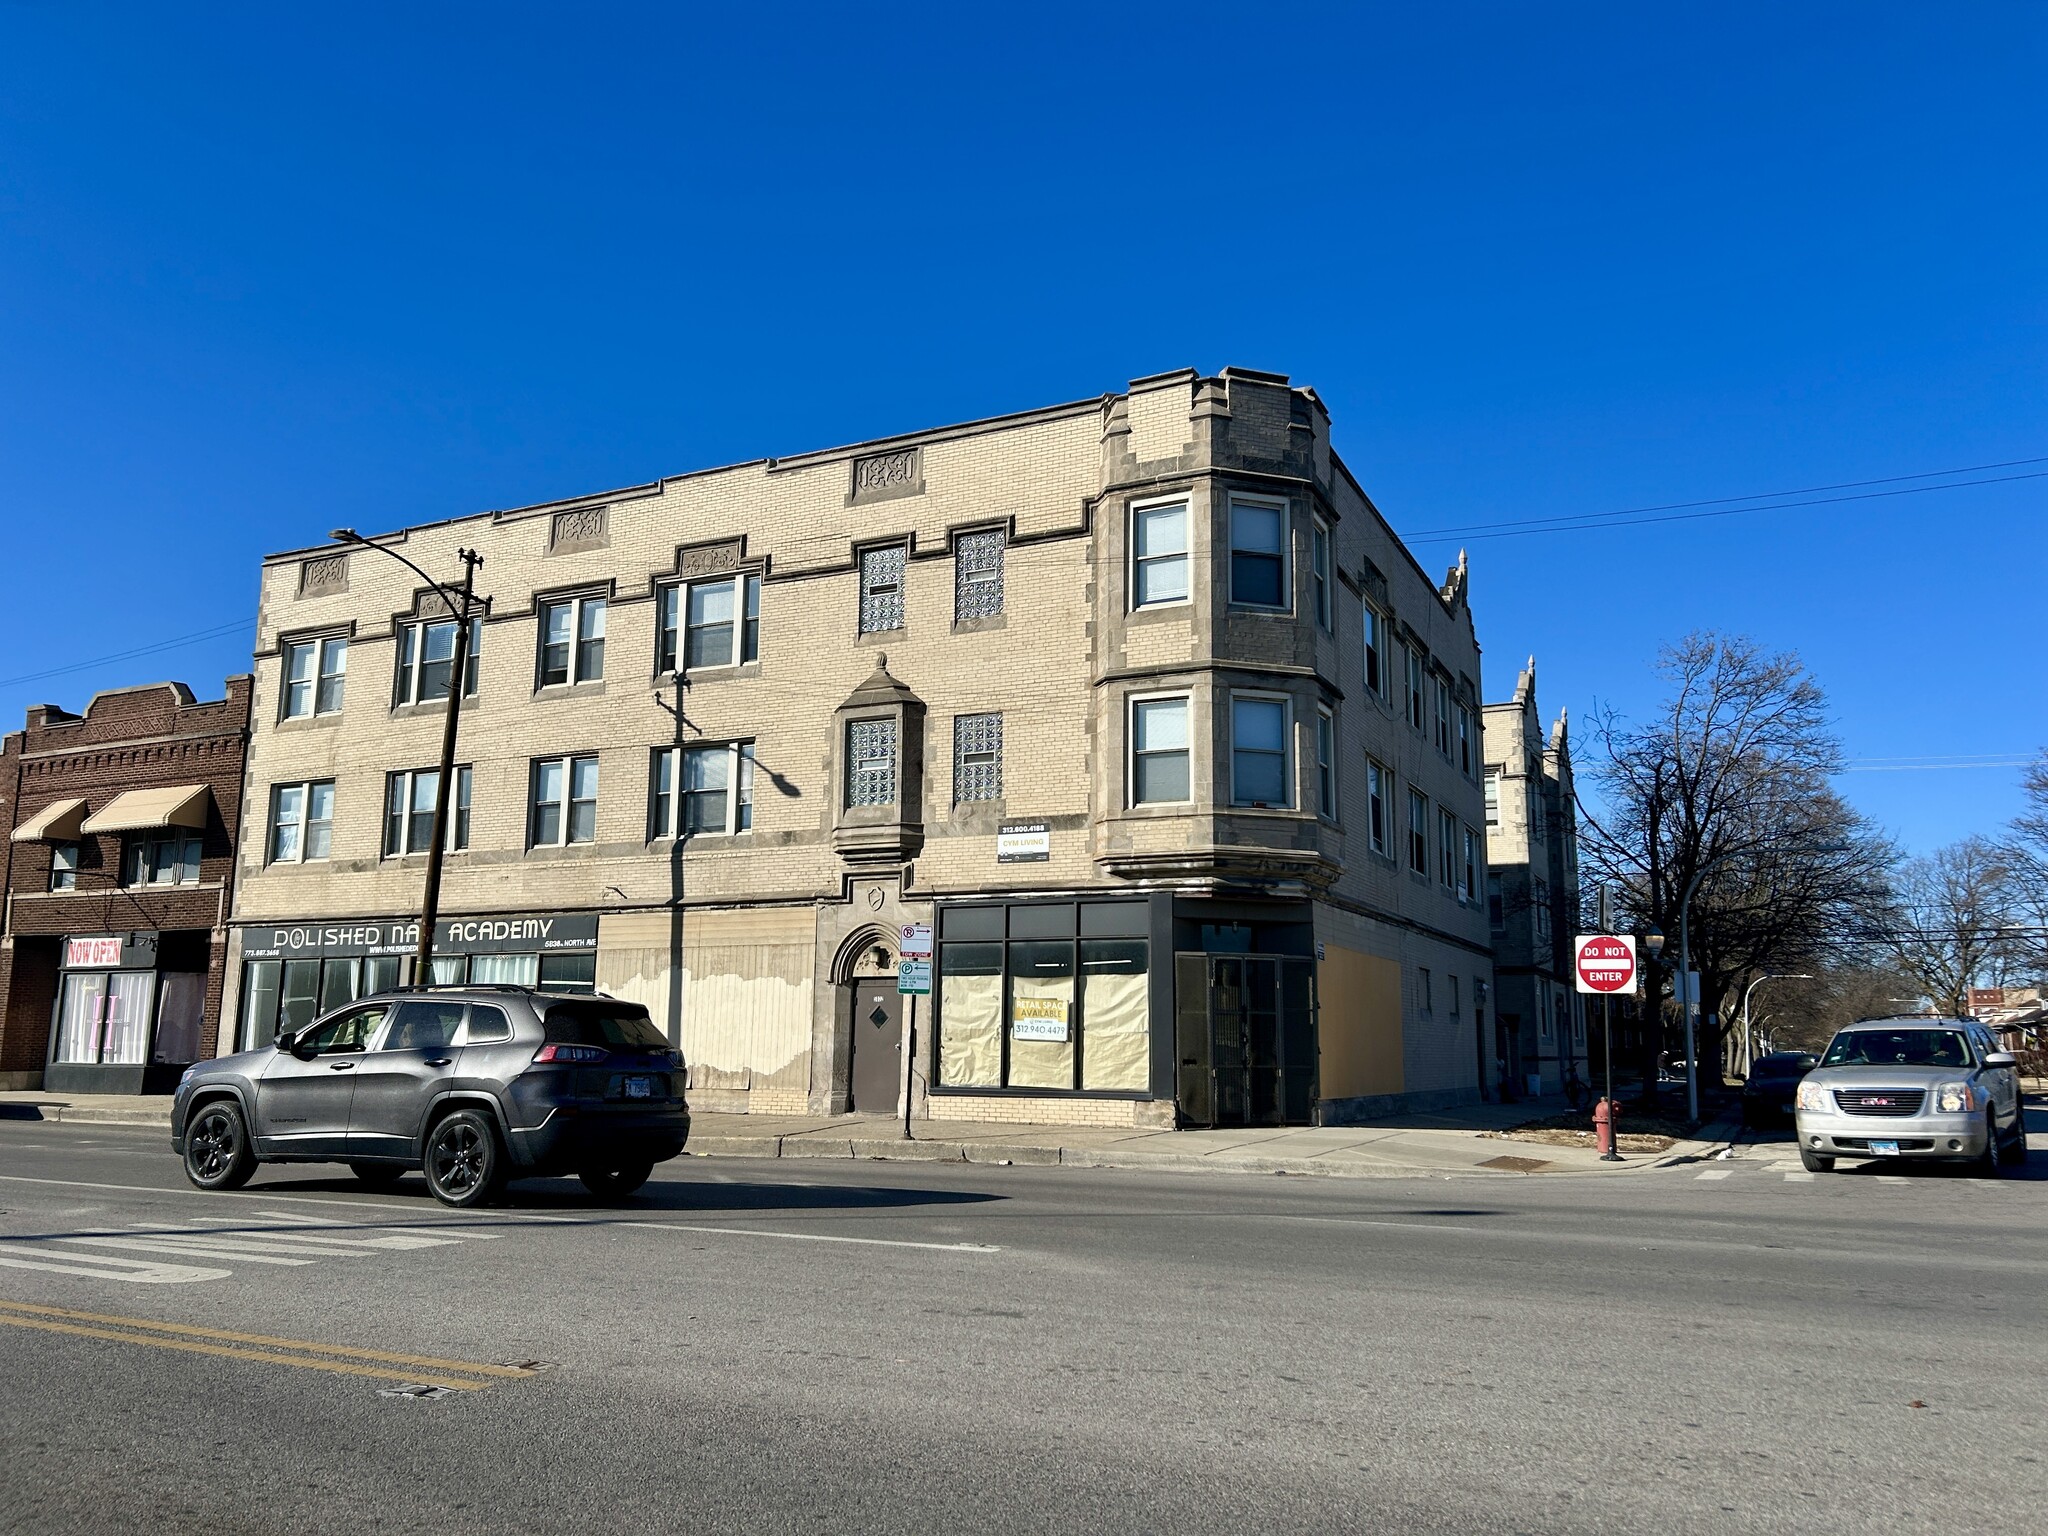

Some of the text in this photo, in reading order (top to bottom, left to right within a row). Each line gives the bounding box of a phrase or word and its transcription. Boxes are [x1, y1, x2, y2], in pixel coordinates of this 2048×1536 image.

[1020, 838, 1044, 846] LIVING
[273, 919, 554, 949] POLISHED NA ACADEMY
[564, 939, 585, 947] NORTH
[586, 938, 597, 946] AVE
[68, 940, 120, 964] NOW OPEN
[1585, 947, 1625, 956] DO NOT
[1589, 972, 1622, 981] ENTER
[1016, 1000, 1041, 1009] RETAIL
[1021, 1009, 1062, 1018] AVAILABLE
